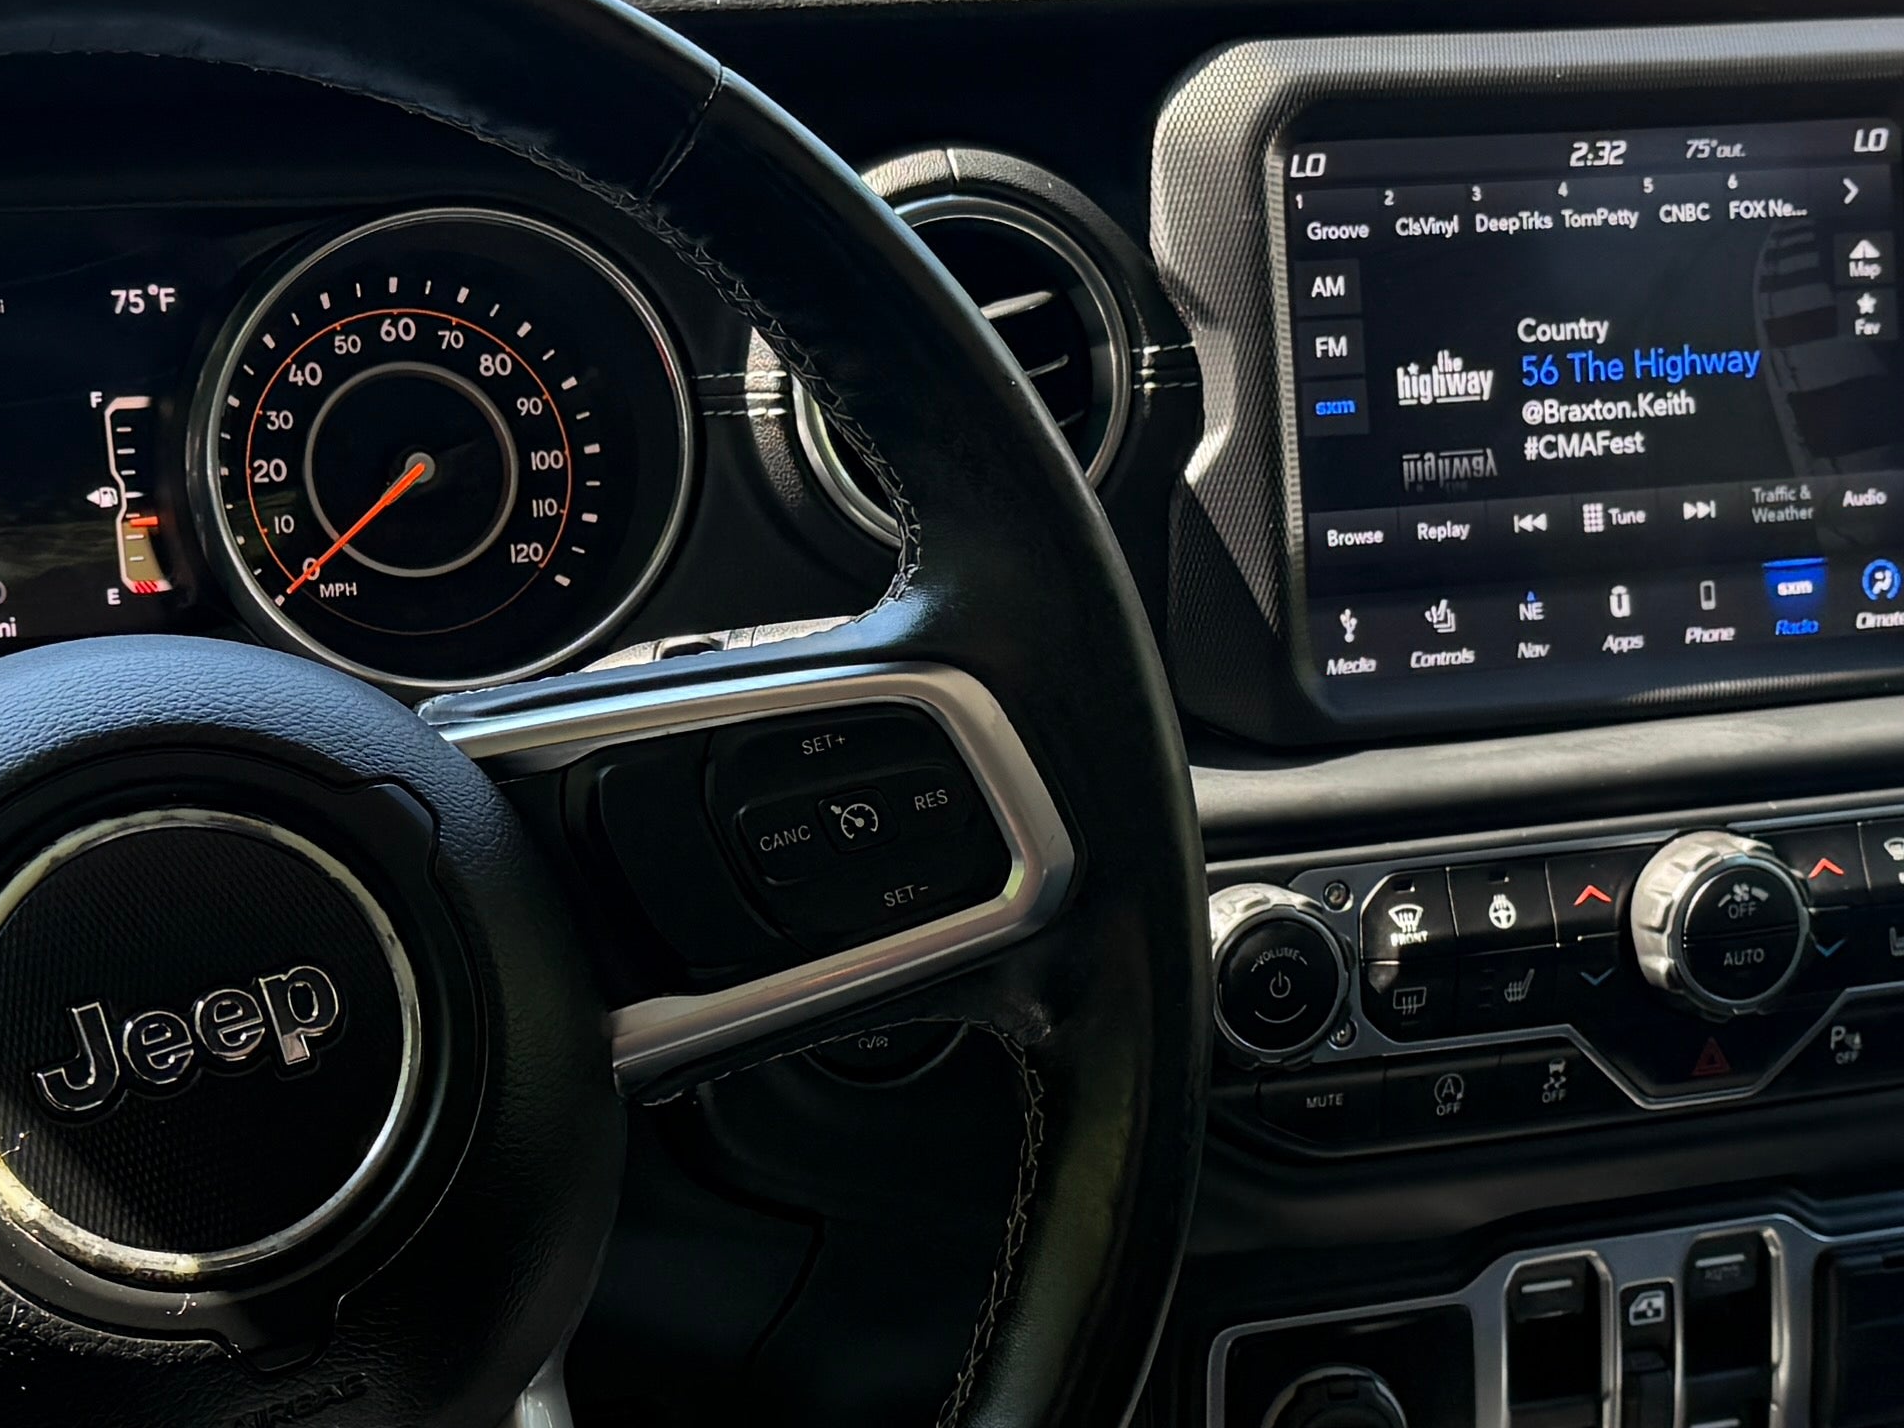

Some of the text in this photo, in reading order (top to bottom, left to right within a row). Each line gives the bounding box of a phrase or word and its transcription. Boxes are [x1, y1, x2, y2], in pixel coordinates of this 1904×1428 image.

[1854, 128, 1889, 153] LO
[1569, 140, 1628, 168] 2:32
[1290, 153, 1326, 178] LO
[1558, 183, 1568, 198] 4
[1644, 178, 1654, 193] 5
[1727, 174, 1738, 190] 6
[1295, 194, 1304, 210] 1
[1384, 189, 1394, 206] 2
[1472, 186, 1482, 203] 3
[1561, 207, 1639, 231] TomPetty
[1658, 203, 1710, 224] CNBC
[1728, 200, 1767, 220] FOX
[1306, 220, 1370, 242] Groove
[1475, 211, 1554, 236] DeepTrks
[1848, 260, 1882, 280] Map
[1311, 276, 1345, 299] AM
[110, 285, 176, 314] 75°F
[379, 319, 416, 342] 60
[1517, 317, 1610, 345] Country
[1854, 317, 1882, 337] Fav
[334, 335, 362, 355] 50
[437, 330, 464, 350] 70
[1315, 337, 1348, 359] FM
[479, 353, 512, 376] 80
[1437, 351, 1463, 373] the
[1520, 347, 1762, 387] 56 The Highway
[288, 364, 323, 386] 40
[1396, 361, 1494, 406] highway
[90, 392, 102, 408] F
[516, 397, 543, 416] 90
[1315, 398, 1356, 417] sxm
[1522, 390, 1696, 428] @Braxton.Keith
[266, 410, 294, 430] 30
[1524, 432, 1645, 461] #CMAFest
[530, 450, 564, 470] 100
[253, 460, 287, 483] 20
[1751, 485, 1811, 505] Traffic &
[1842, 488, 1887, 508] Audio
[532, 498, 558, 517] 110
[1607, 506, 1646, 527] Tune
[1752, 503, 1815, 524] Weather
[274, 515, 295, 535] 10
[1417, 520, 1470, 543] Replay
[1327, 526, 1384, 548] Browse
[510, 543, 543, 563] 120
[107, 589, 120, 605] E
[319, 582, 357, 598] MPH
[1518, 601, 1544, 622] NE
[1685, 626, 1736, 644] Phone
[1775, 619, 1820, 636] Radio
[1517, 640, 1550, 660] Nav
[1603, 631, 1645, 654] Apps
[1327, 654, 1377, 676] Media
[1410, 645, 1475, 669] Controls
[914, 788, 949, 811] RES
[759, 825, 811, 853] CANC
[1728, 901, 1758, 920] OFF
[1723, 947, 1765, 967] AUTO
[32, 964, 342, 1113] Jeep
[1835, 1050, 1859, 1065] OFF
[1306, 1093, 1344, 1110] MUTE
[1542, 1088, 1566, 1104] OFF
[1436, 1102, 1461, 1117] OFF
